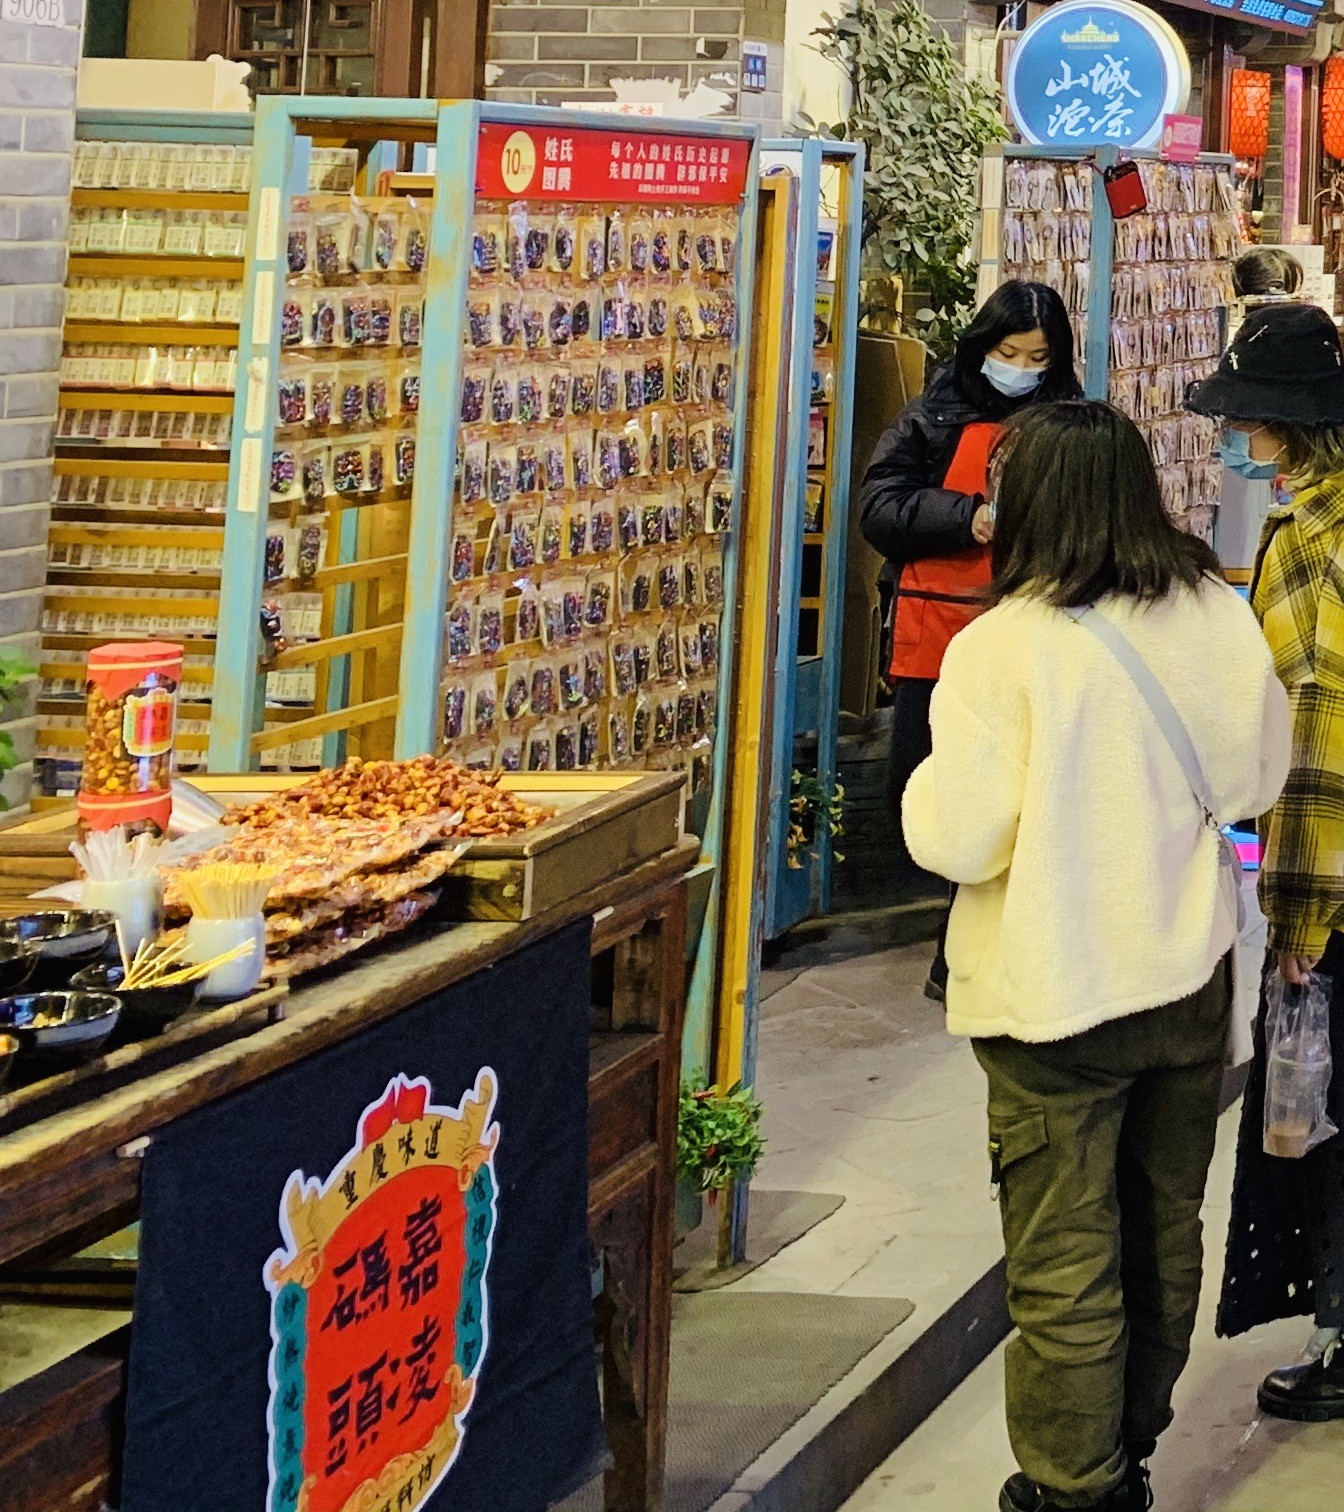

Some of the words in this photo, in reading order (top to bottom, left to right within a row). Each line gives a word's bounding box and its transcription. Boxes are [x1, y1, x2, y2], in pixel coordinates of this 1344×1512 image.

[1045, 53, 1141, 98] 山城
[1047, 93, 1134, 138] 泡茶
[543, 136, 574, 162] 姓氏
[541, 166, 573, 192] 图腾
[608, 162, 666, 181] 先祖的图腾
[338, 1117, 444, 1211] 重慶味道
